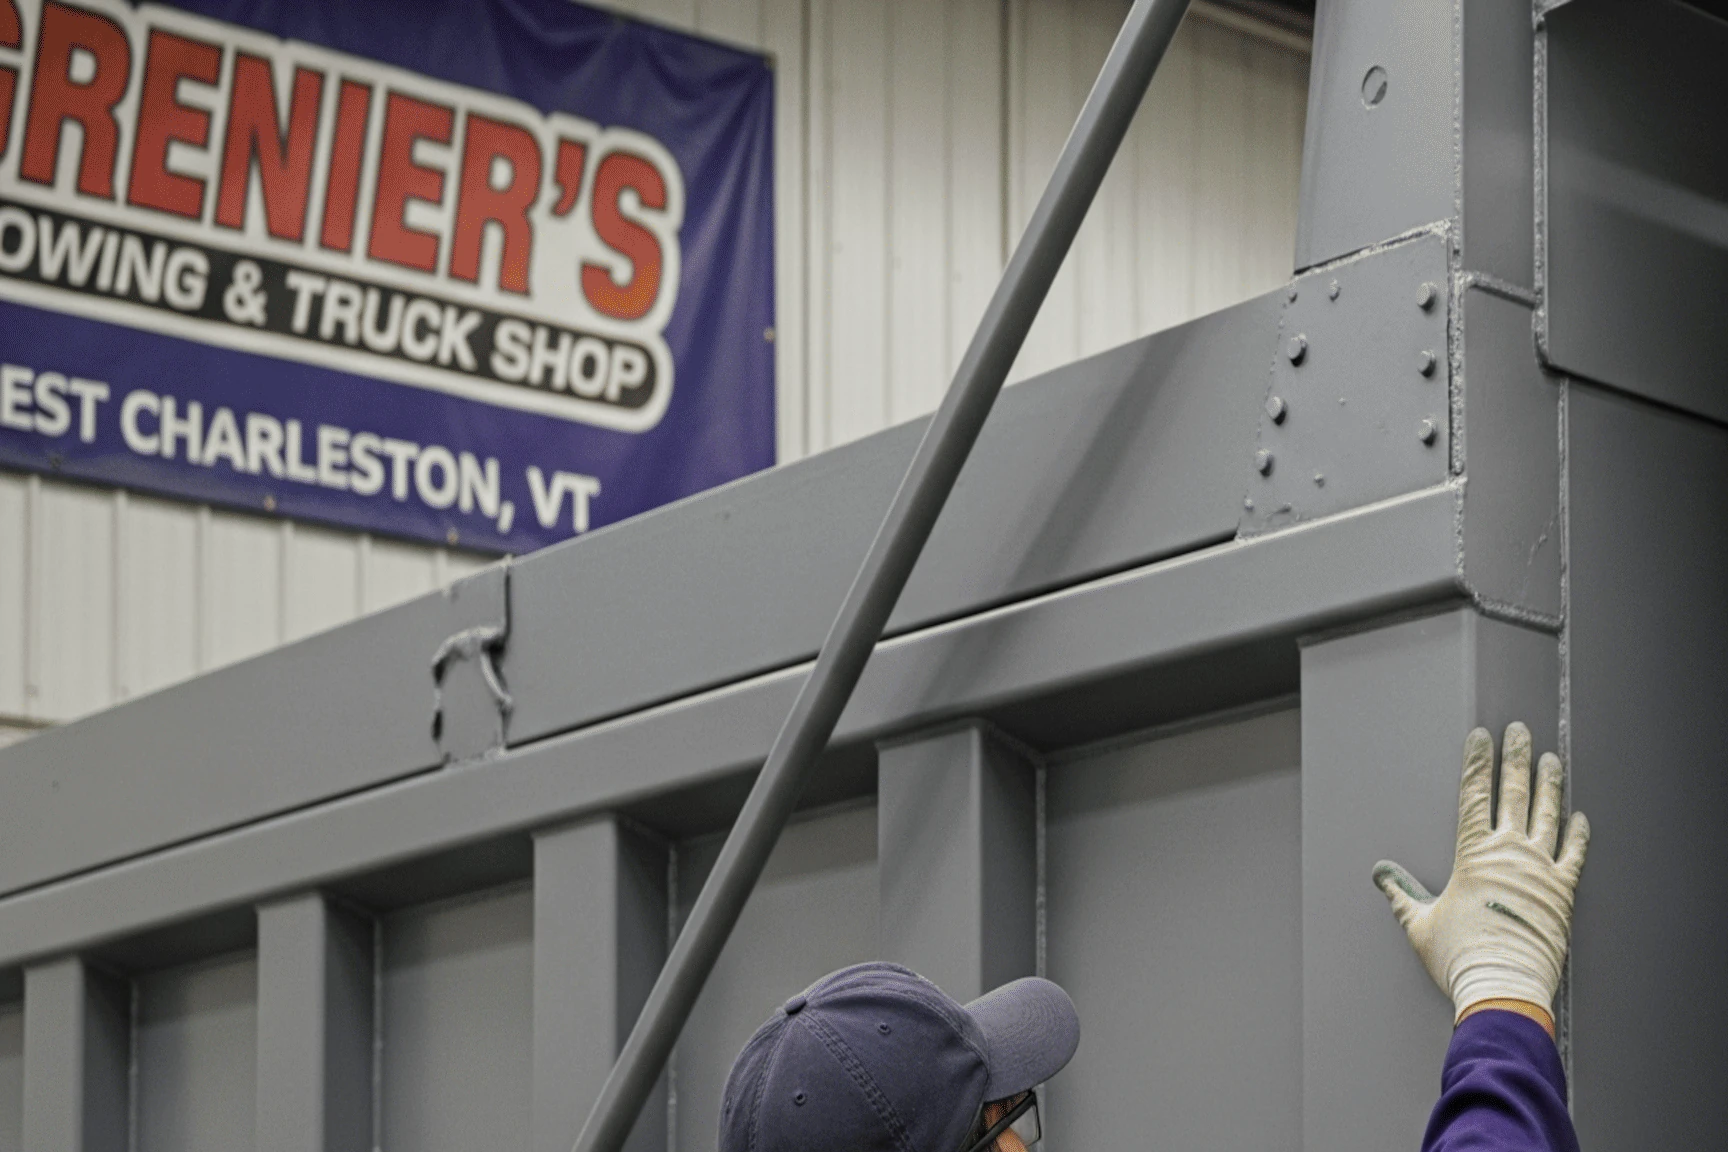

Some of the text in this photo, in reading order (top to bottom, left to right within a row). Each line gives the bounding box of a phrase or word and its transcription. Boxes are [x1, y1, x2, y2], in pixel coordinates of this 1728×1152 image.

[0, 0, 668, 322] RENIER'S
[223, 263, 268, 326] &
[285, 275, 480, 370] TRUCK
[490, 328, 648, 402] SHOP
[120, 390, 516, 533] CHARLESTON,
[527, 468, 601, 532] VT
